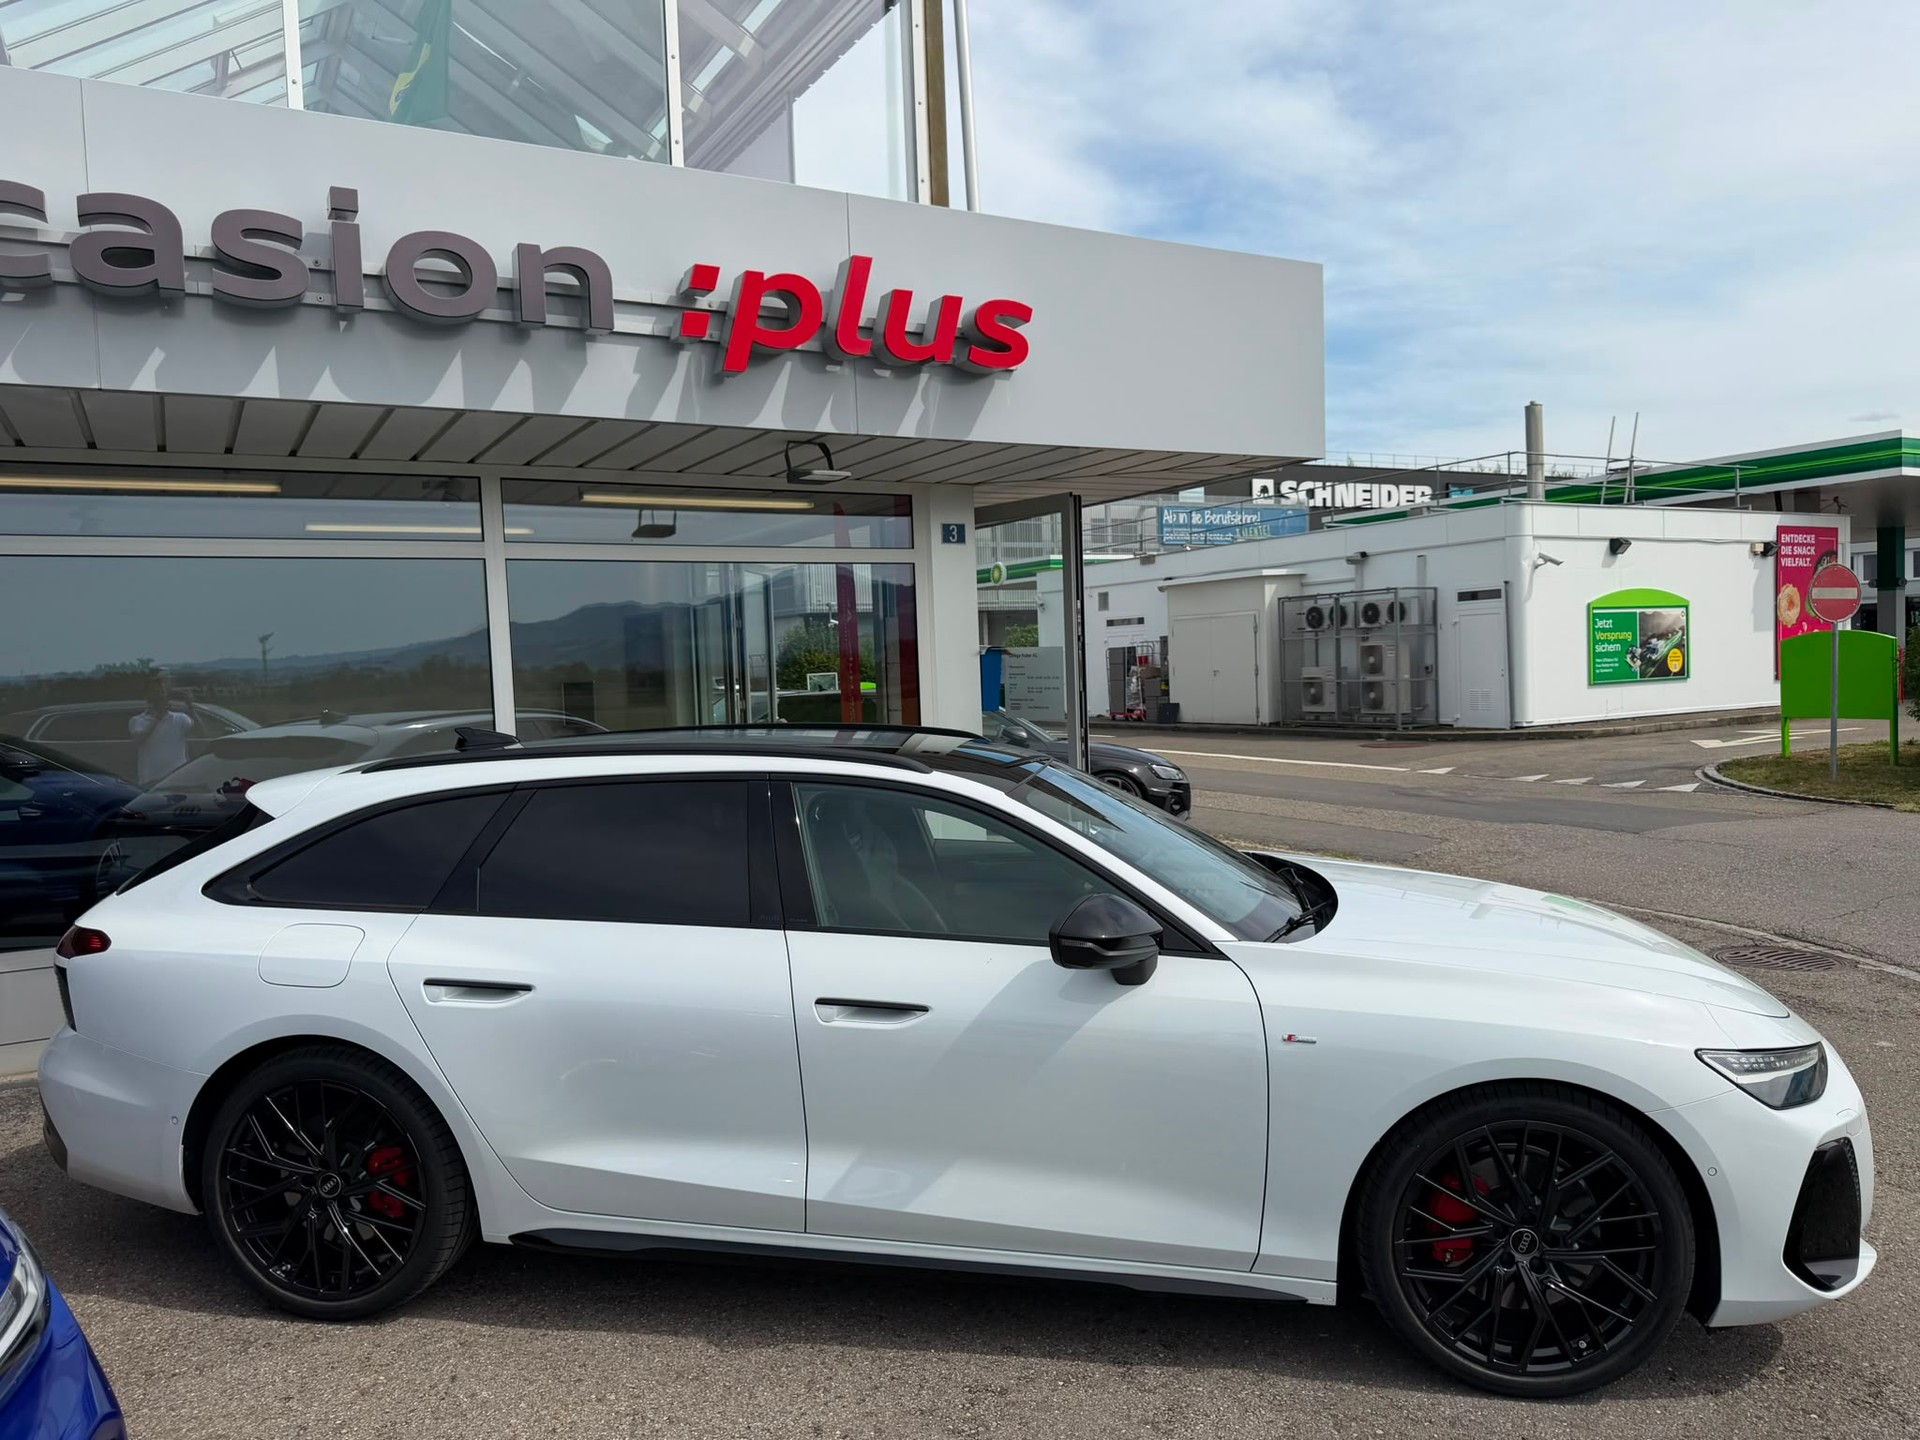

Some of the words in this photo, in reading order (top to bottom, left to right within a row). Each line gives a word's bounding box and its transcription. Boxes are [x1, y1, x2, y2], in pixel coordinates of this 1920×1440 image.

[1279, 480, 1433, 509] SCHNEIDER
[949, 524, 958, 542] 3
[1781, 534, 1816, 544] ENTDECKE
[1781, 546, 1793, 555] DIE
[1793, 546, 1816, 556] SNACK
[1781, 557, 1812, 567] VIELFALT.
[1594, 618, 1613, 628] Jetzt
[1594, 631, 1632, 641] Vorsprung
[1594, 642, 1621, 653] sichern
